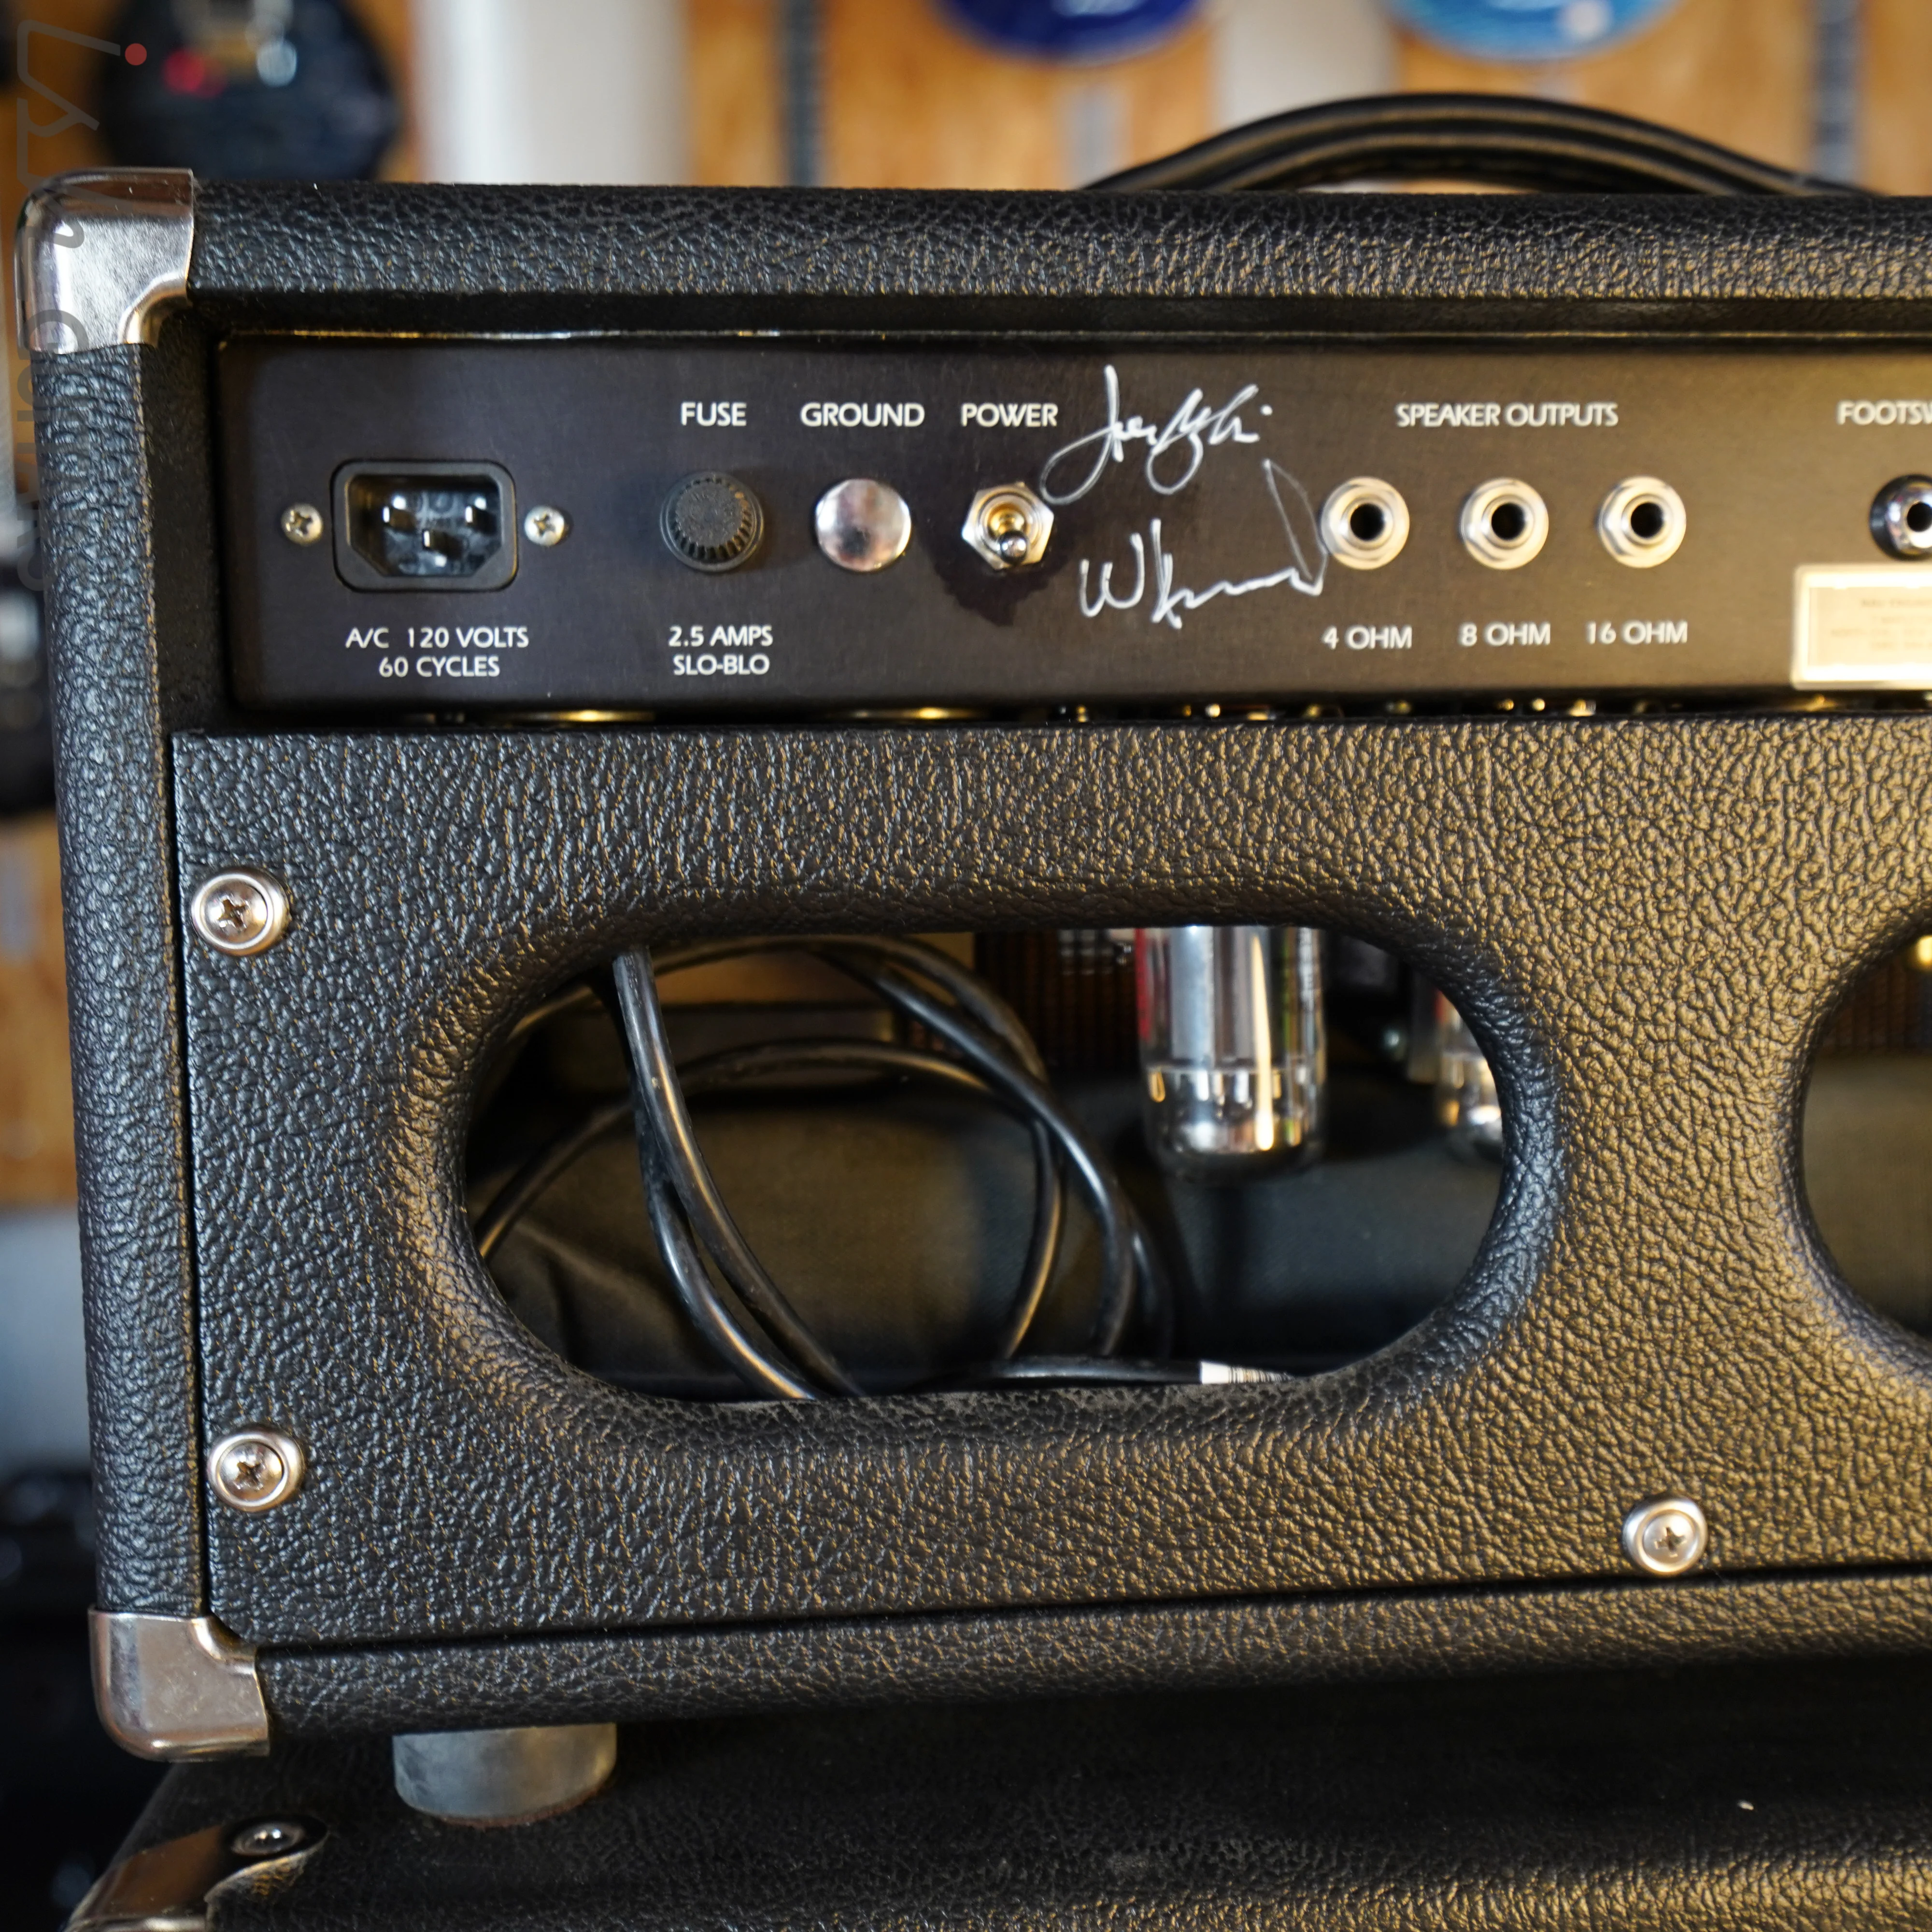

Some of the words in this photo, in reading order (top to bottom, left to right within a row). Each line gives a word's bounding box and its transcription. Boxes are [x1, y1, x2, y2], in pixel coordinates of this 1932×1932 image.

[680, 401, 747, 427] FUSE
[800, 402, 925, 427] GROUND
[961, 402, 1059, 428] POWER
[1395, 403, 1501, 427] SPEAKER
[1505, 402, 1619, 427] OUTPUTS
[345, 627, 389, 649] A/C
[408, 626, 450, 649] 120
[455, 626, 529, 649] VOLTS
[668, 625, 705, 647] 2.5
[710, 625, 773, 647] AMPS
[1321, 625, 1340, 650] 4
[1346, 625, 1413, 650] OHM
[1459, 623, 1478, 647] 8
[1485, 622, 1551, 646] OHM
[1587, 622, 1616, 644] 16
[1623, 621, 1688, 645] OHM
[378, 656, 409, 678] 60
[416, 655, 500, 678] CYCLES
[673, 653, 770, 676] SLO-BLO
